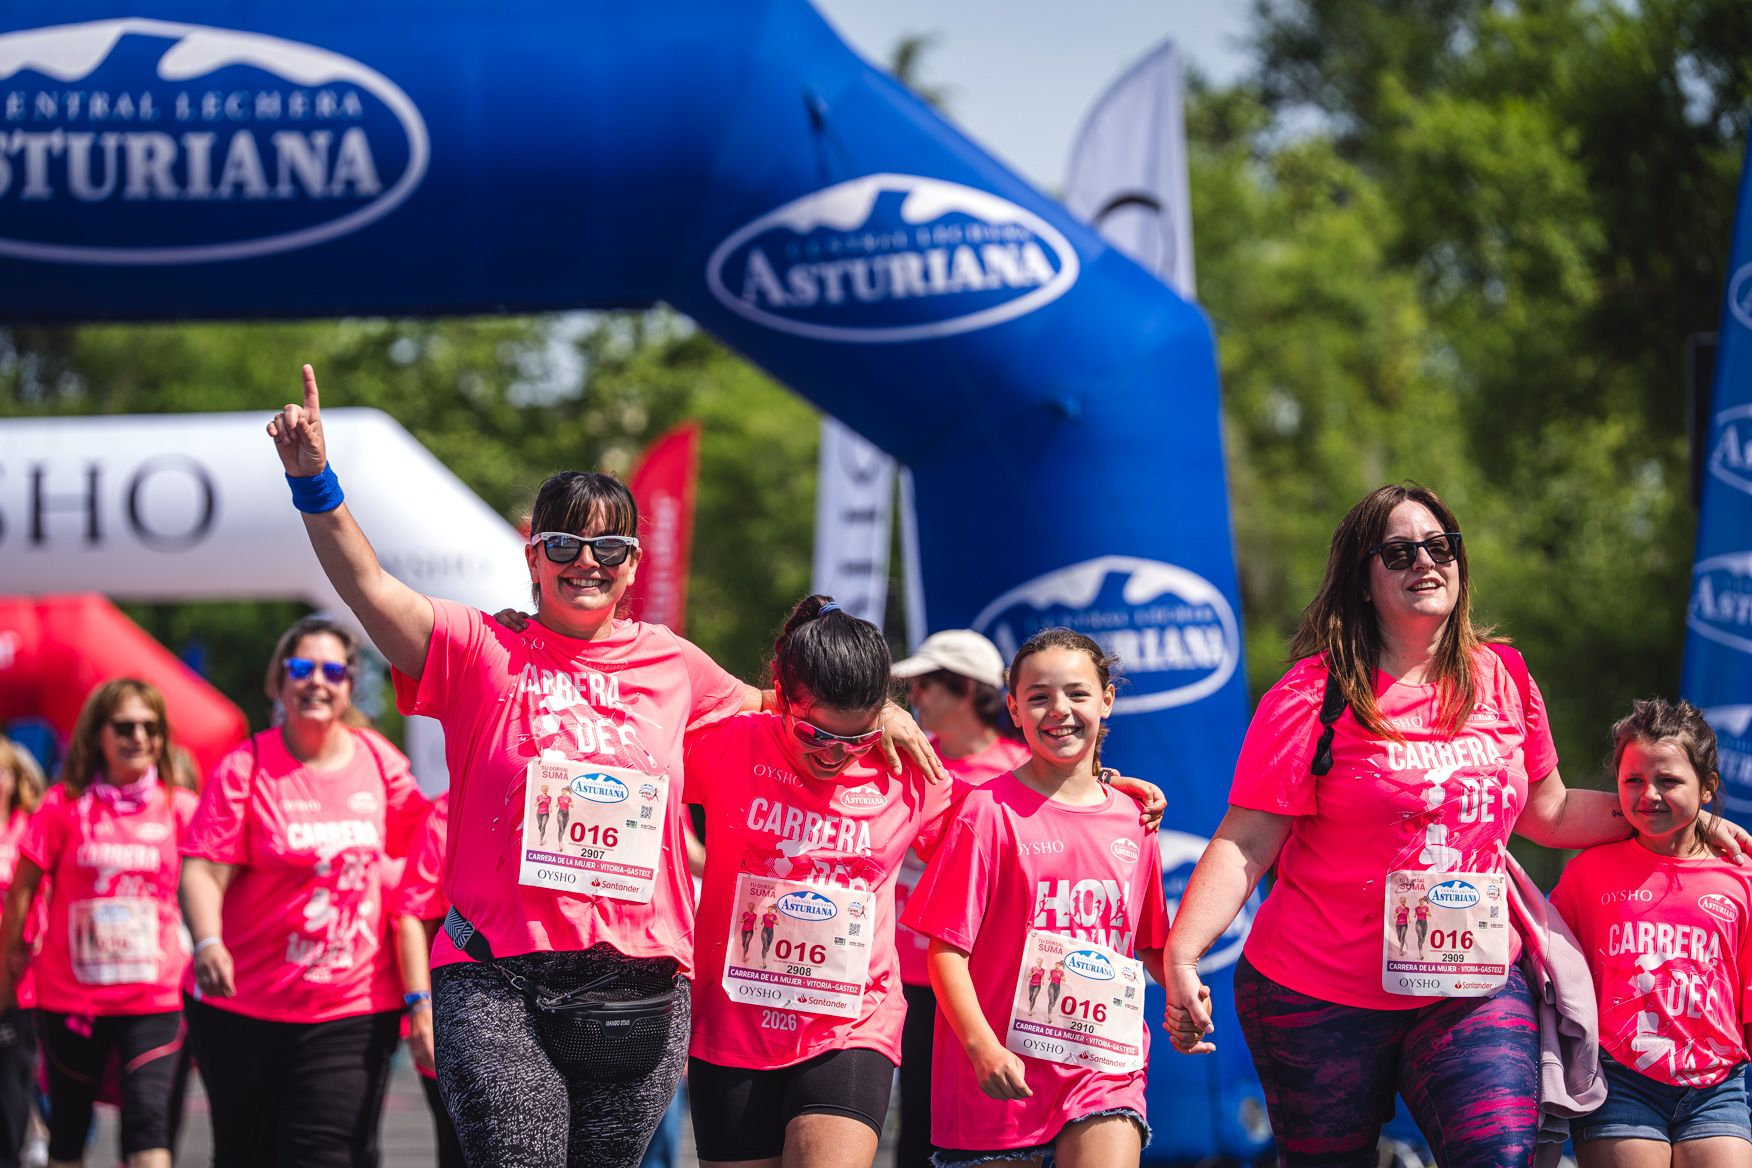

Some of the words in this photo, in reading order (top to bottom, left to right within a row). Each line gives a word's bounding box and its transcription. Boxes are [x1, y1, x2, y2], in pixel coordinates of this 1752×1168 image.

[742, 242, 1058, 308] ASTURIANA
[0, 453, 222, 553] HO
[1388, 735, 1503, 771] CARRERA
[542, 771, 569, 780] SUMA
[575, 781, 625, 799] ASTURIANA
[1459, 777, 1498, 823] DE
[570, 822, 618, 848] 016
[747, 796, 872, 857] CARRERA
[528, 852, 556, 864] CARRERA
[557, 857, 565, 865] DE
[566, 858, 574, 866] LA
[575, 859, 596, 869] MUJER
[580, 848, 605, 860] 2907
[537, 869, 577, 884] OYSHO
[601, 880, 640, 893] Santander
[1400, 883, 1426, 891] SUMA
[750, 887, 776, 899] SUMA
[1432, 889, 1477, 902] ASTURIANA
[1601, 889, 1653, 905] OYSHO
[781, 898, 832, 916] ASTURIANA
[1034, 879, 1130, 928] HOY
[1038, 944, 1063, 955] SUMA
[1430, 930, 1474, 949] 016
[1608, 920, 1720, 962] CARRERA
[775, 939, 827, 965] 016
[1442, 954, 1465, 963] 2909
[786, 965, 812, 977] 2908
[1068, 955, 1113, 977] ASTURIANA
[1389, 963, 1418, 971] CARRERA
[730, 969, 760, 980] CARRERA
[760, 973, 769, 981] DE
[780, 976, 802, 986] MUJER
[1399, 978, 1440, 989] OYSHO
[1462, 981, 1493, 990] Santander
[739, 984, 782, 1000] OYSHO
[808, 996, 848, 1009] Santander
[1666, 971, 1705, 1019] DE
[1060, 995, 1107, 1023] 016
[761, 1010, 797, 1031] 2026
[1070, 1021, 1095, 1034] 2910
[1015, 1021, 1044, 1034] CARRERA
[1045, 1026, 1054, 1035] DE
[1054, 1028, 1062, 1037] LA
[1064, 1030, 1085, 1042] MUJER
[1023, 1038, 1064, 1055] OYSHO
[1089, 1053, 1126, 1068] Santander
